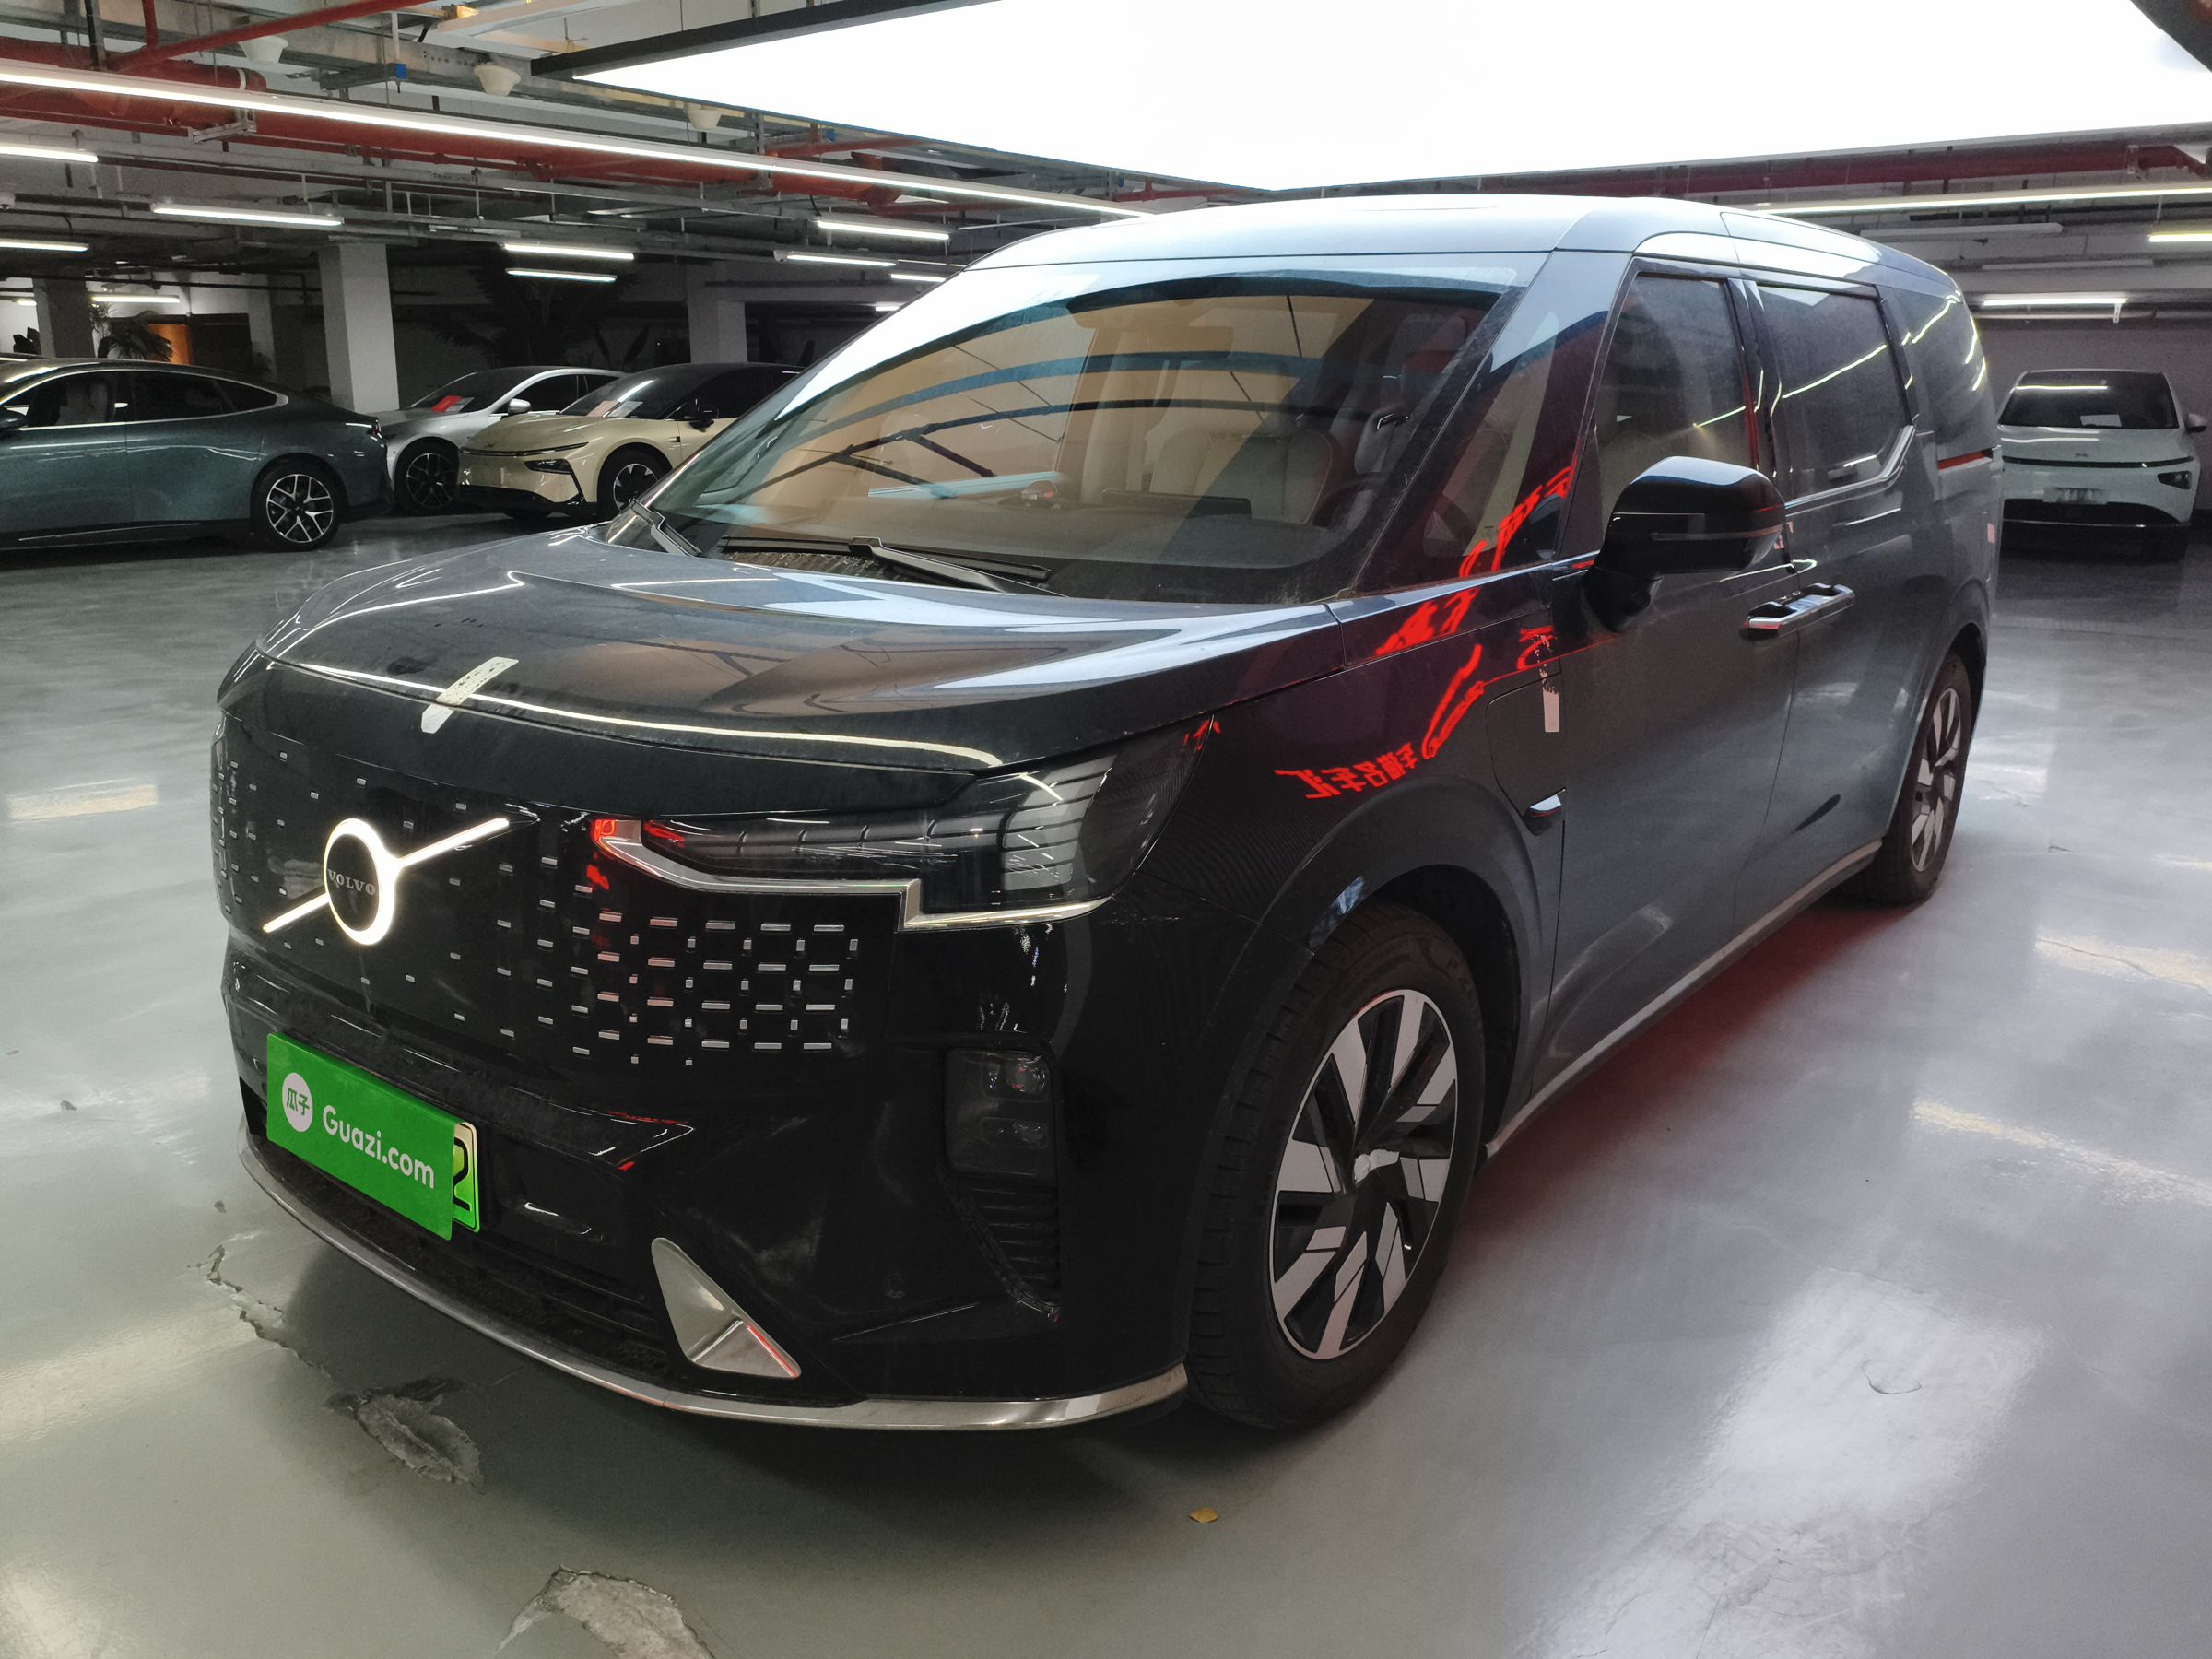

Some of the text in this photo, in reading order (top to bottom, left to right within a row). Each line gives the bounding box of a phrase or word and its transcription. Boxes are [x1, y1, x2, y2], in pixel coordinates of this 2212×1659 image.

[327, 869, 376, 896] VOLVO
[286, 1087, 310, 1116] 瓜子
[323, 1104, 436, 1190] Guazi.com
